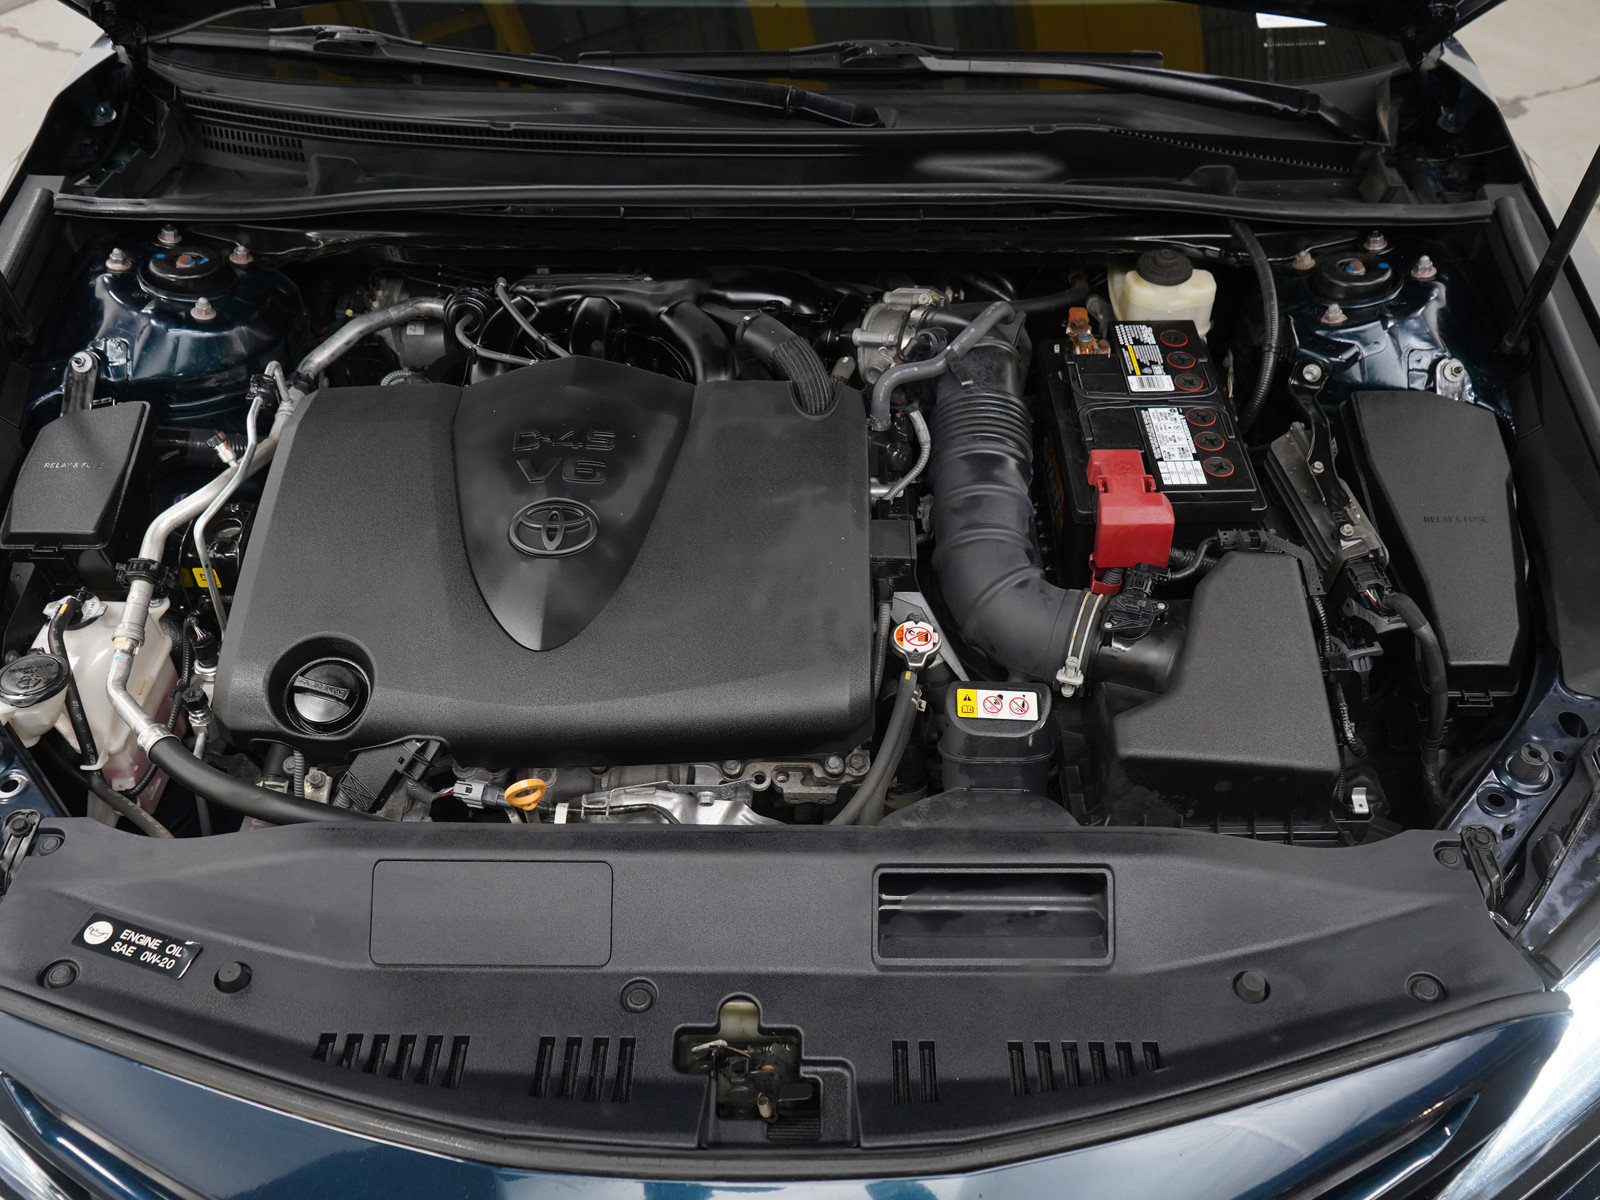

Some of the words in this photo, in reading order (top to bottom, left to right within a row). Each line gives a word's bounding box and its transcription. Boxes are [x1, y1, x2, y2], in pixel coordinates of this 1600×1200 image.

[516, 458, 606, 484] V6
[110, 941, 137, 957] SAE
[139, 950, 176, 970] 0W-20
[119, 928, 163, 951] ENGINE
[165, 943, 184, 958] OIL
